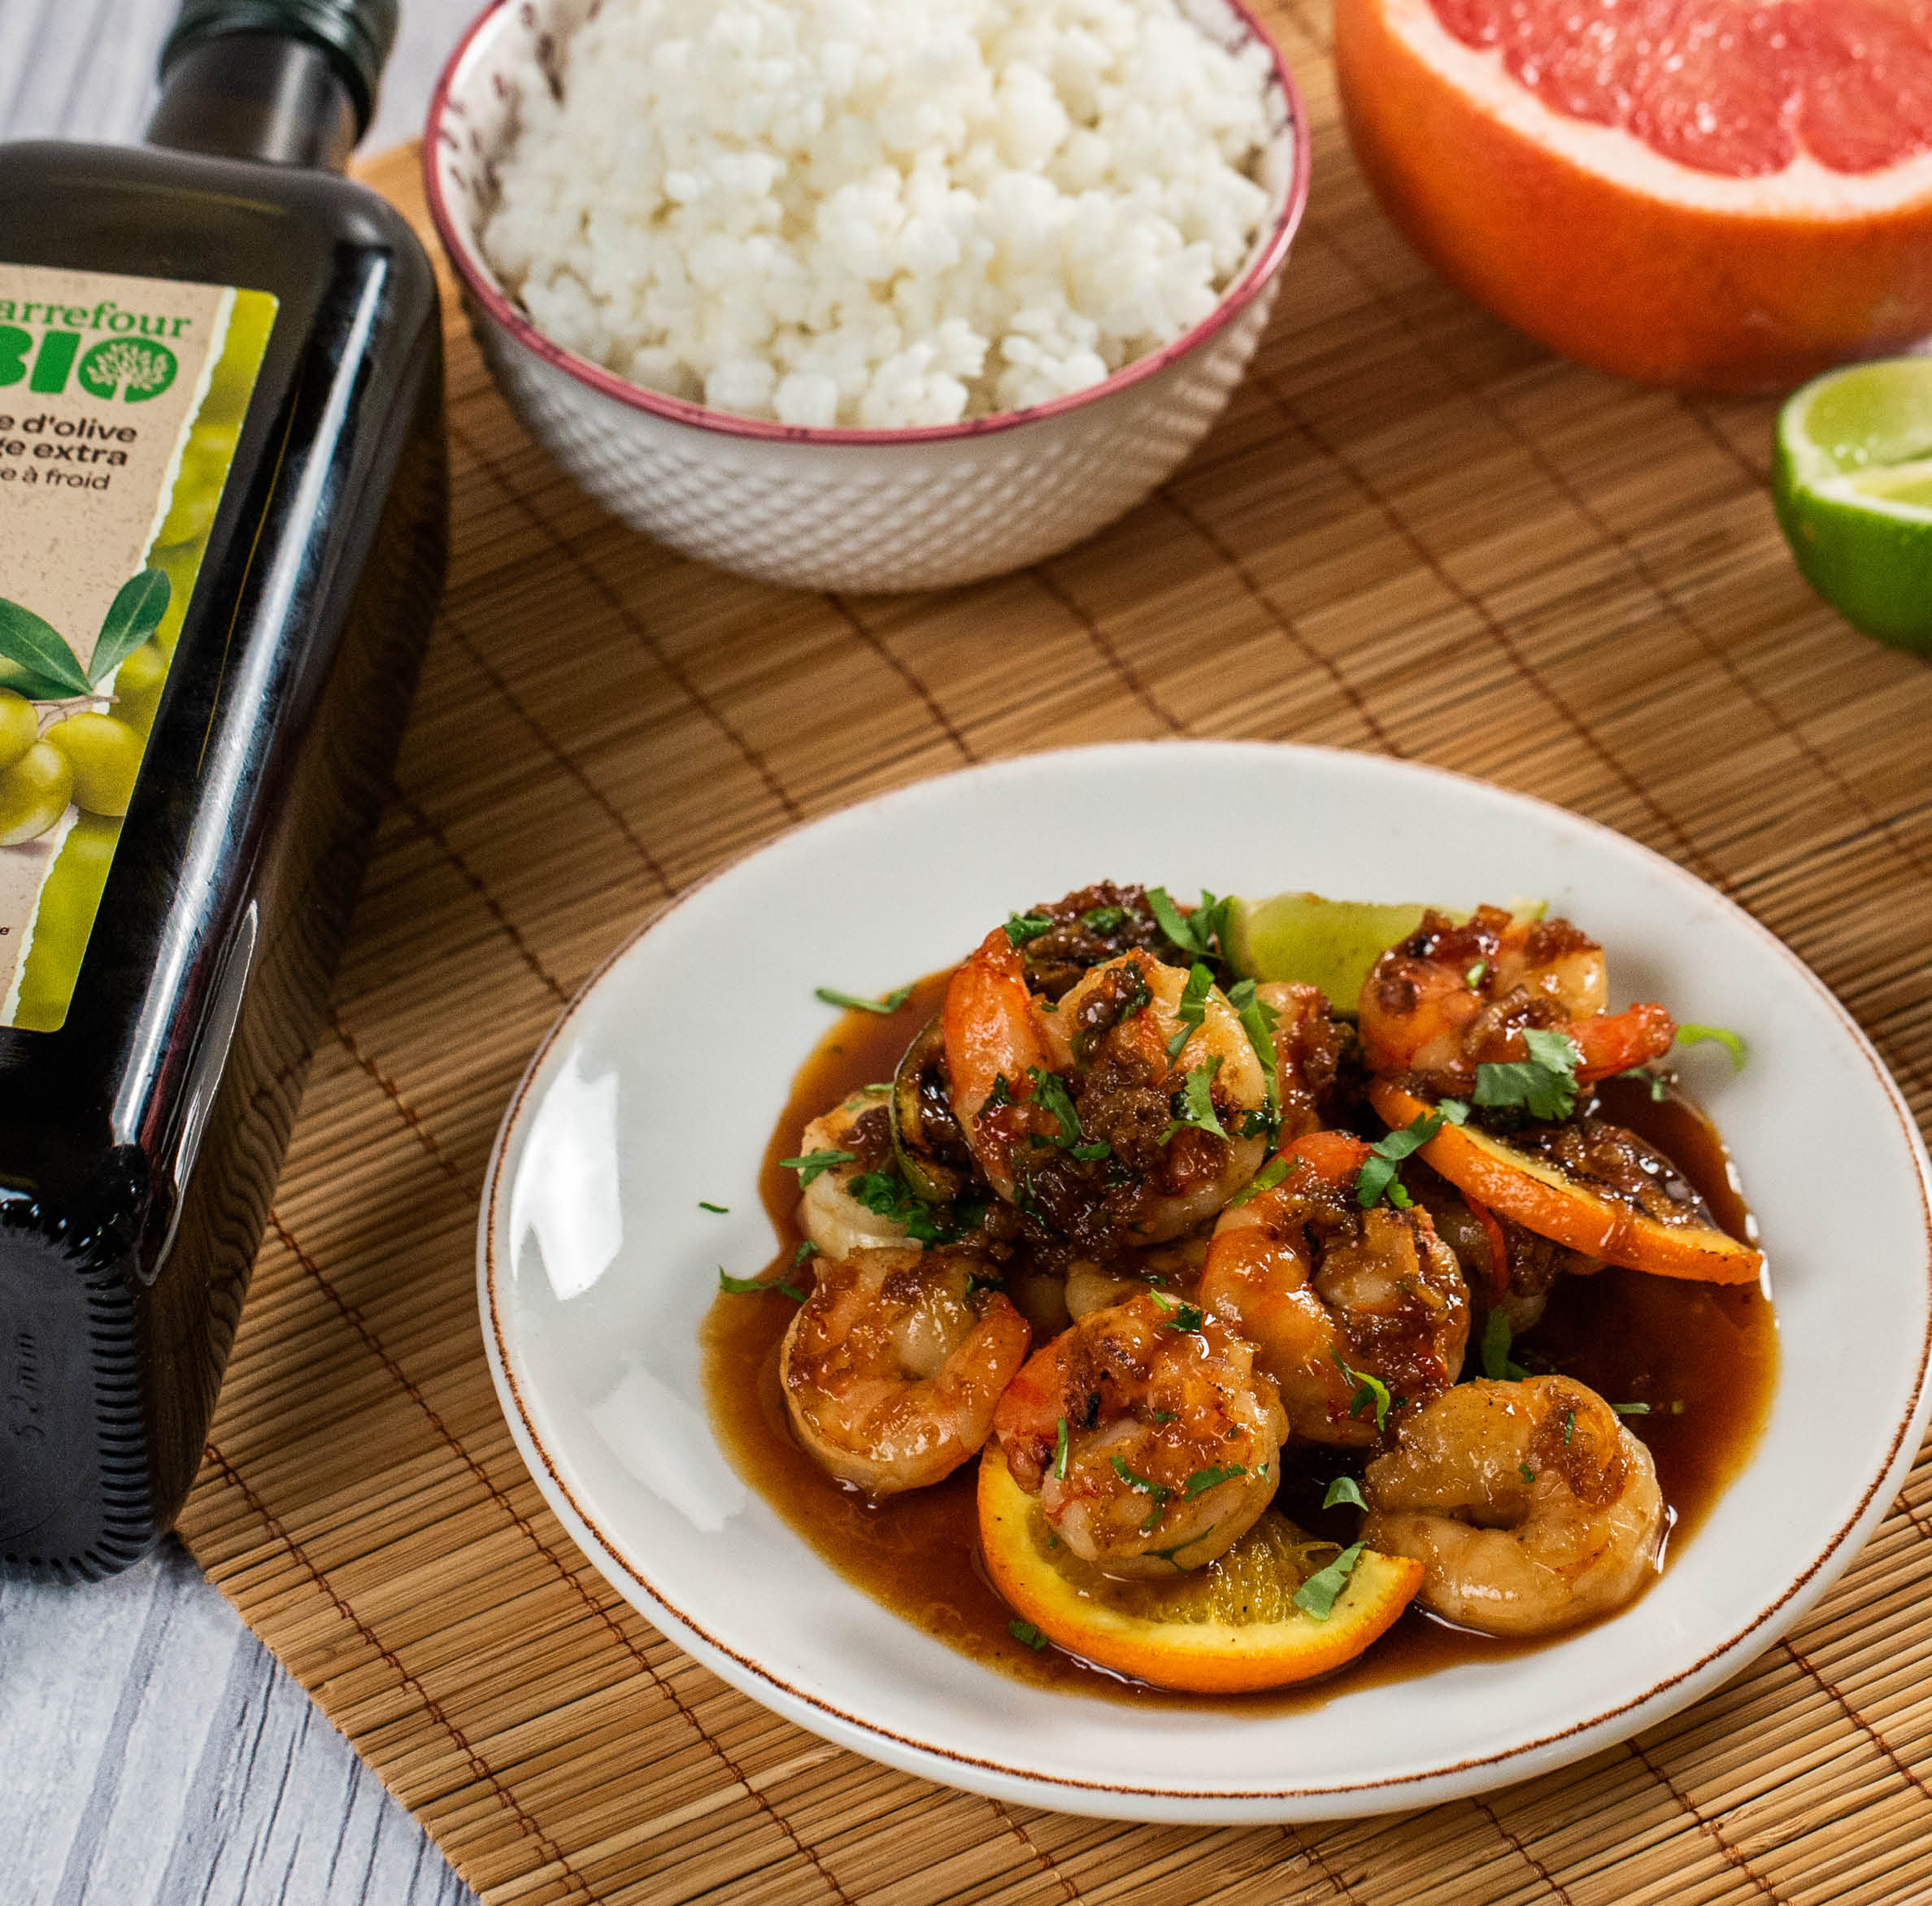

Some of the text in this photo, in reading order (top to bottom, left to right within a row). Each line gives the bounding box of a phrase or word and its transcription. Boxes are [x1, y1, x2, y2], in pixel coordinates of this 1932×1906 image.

[22, 413, 138, 443] d'olive
[33, 442, 128, 467] extra
[22, 465, 38, 485] à
[46, 468, 111, 490] froid
